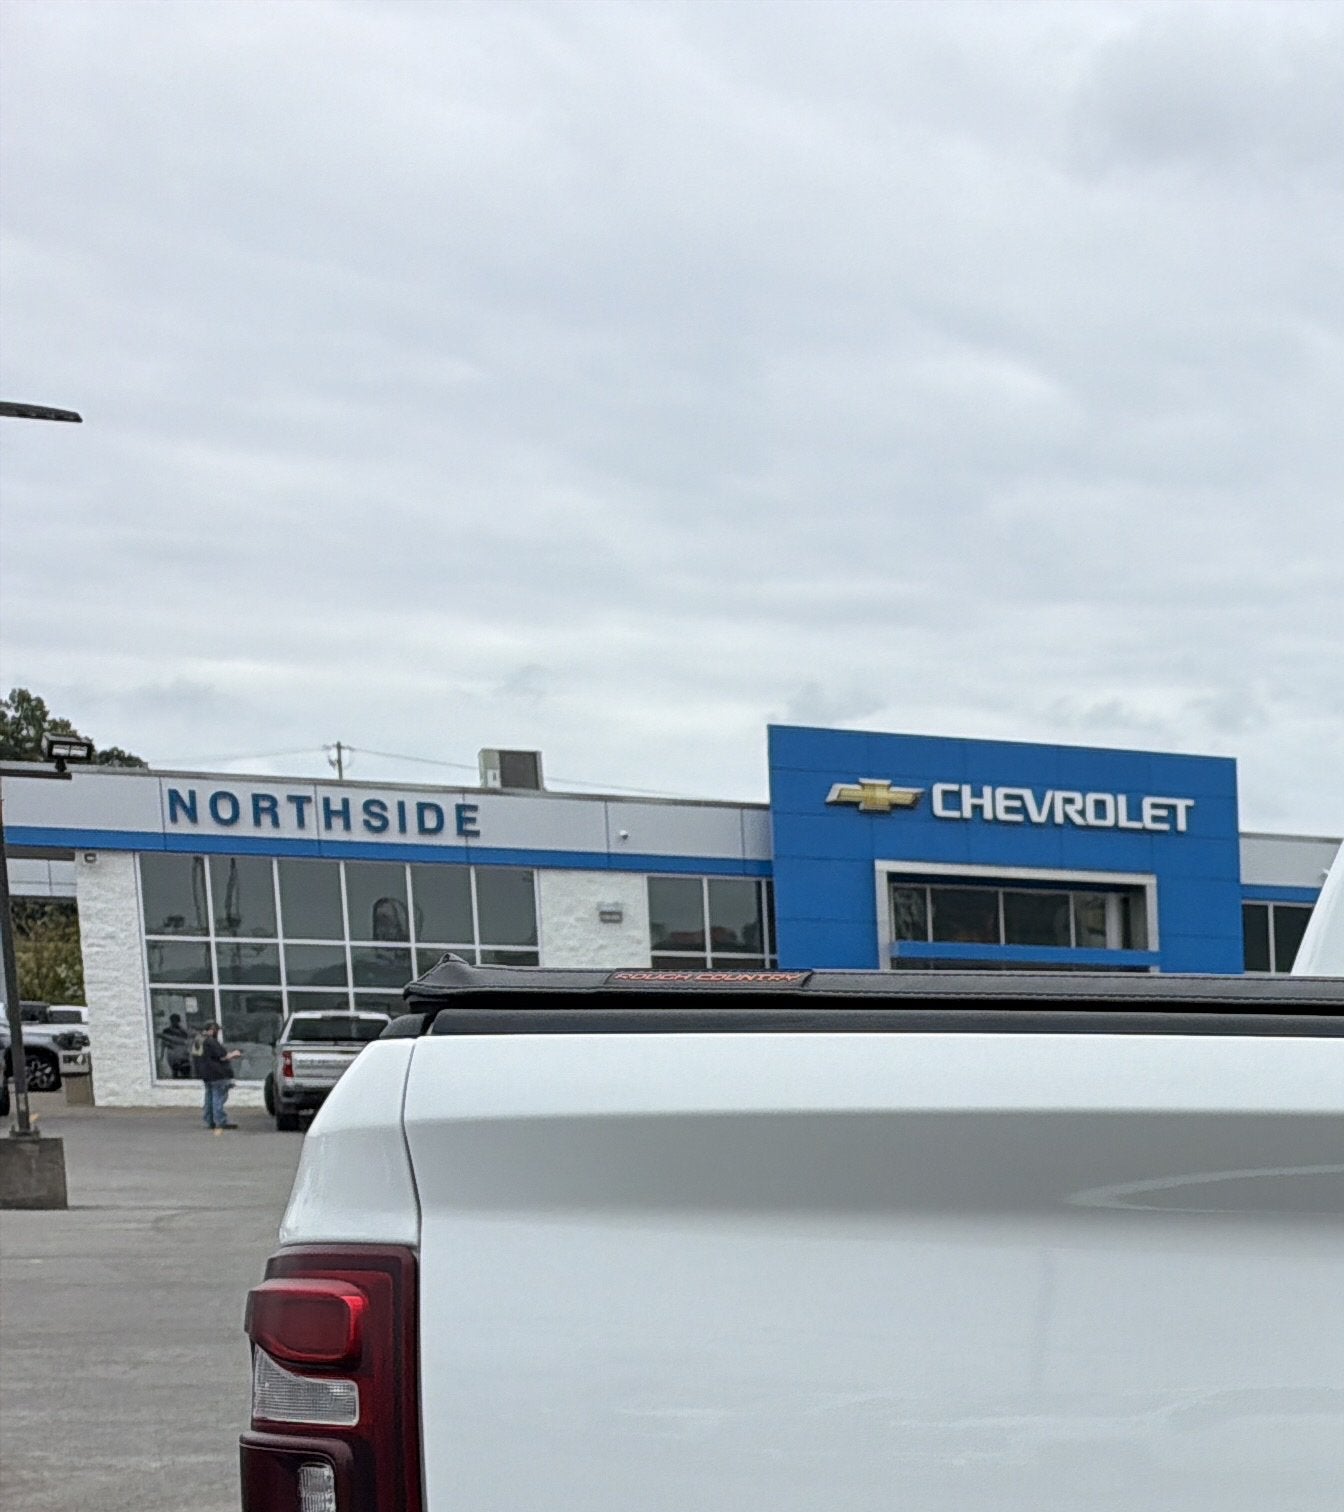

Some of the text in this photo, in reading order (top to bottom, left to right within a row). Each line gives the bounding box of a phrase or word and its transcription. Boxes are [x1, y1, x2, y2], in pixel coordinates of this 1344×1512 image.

[167, 788, 482, 838] NORTHSIDE
[931, 783, 1195, 832] CHEVROLET
[614, 971, 801, 983] ROUGH COUNTRY
